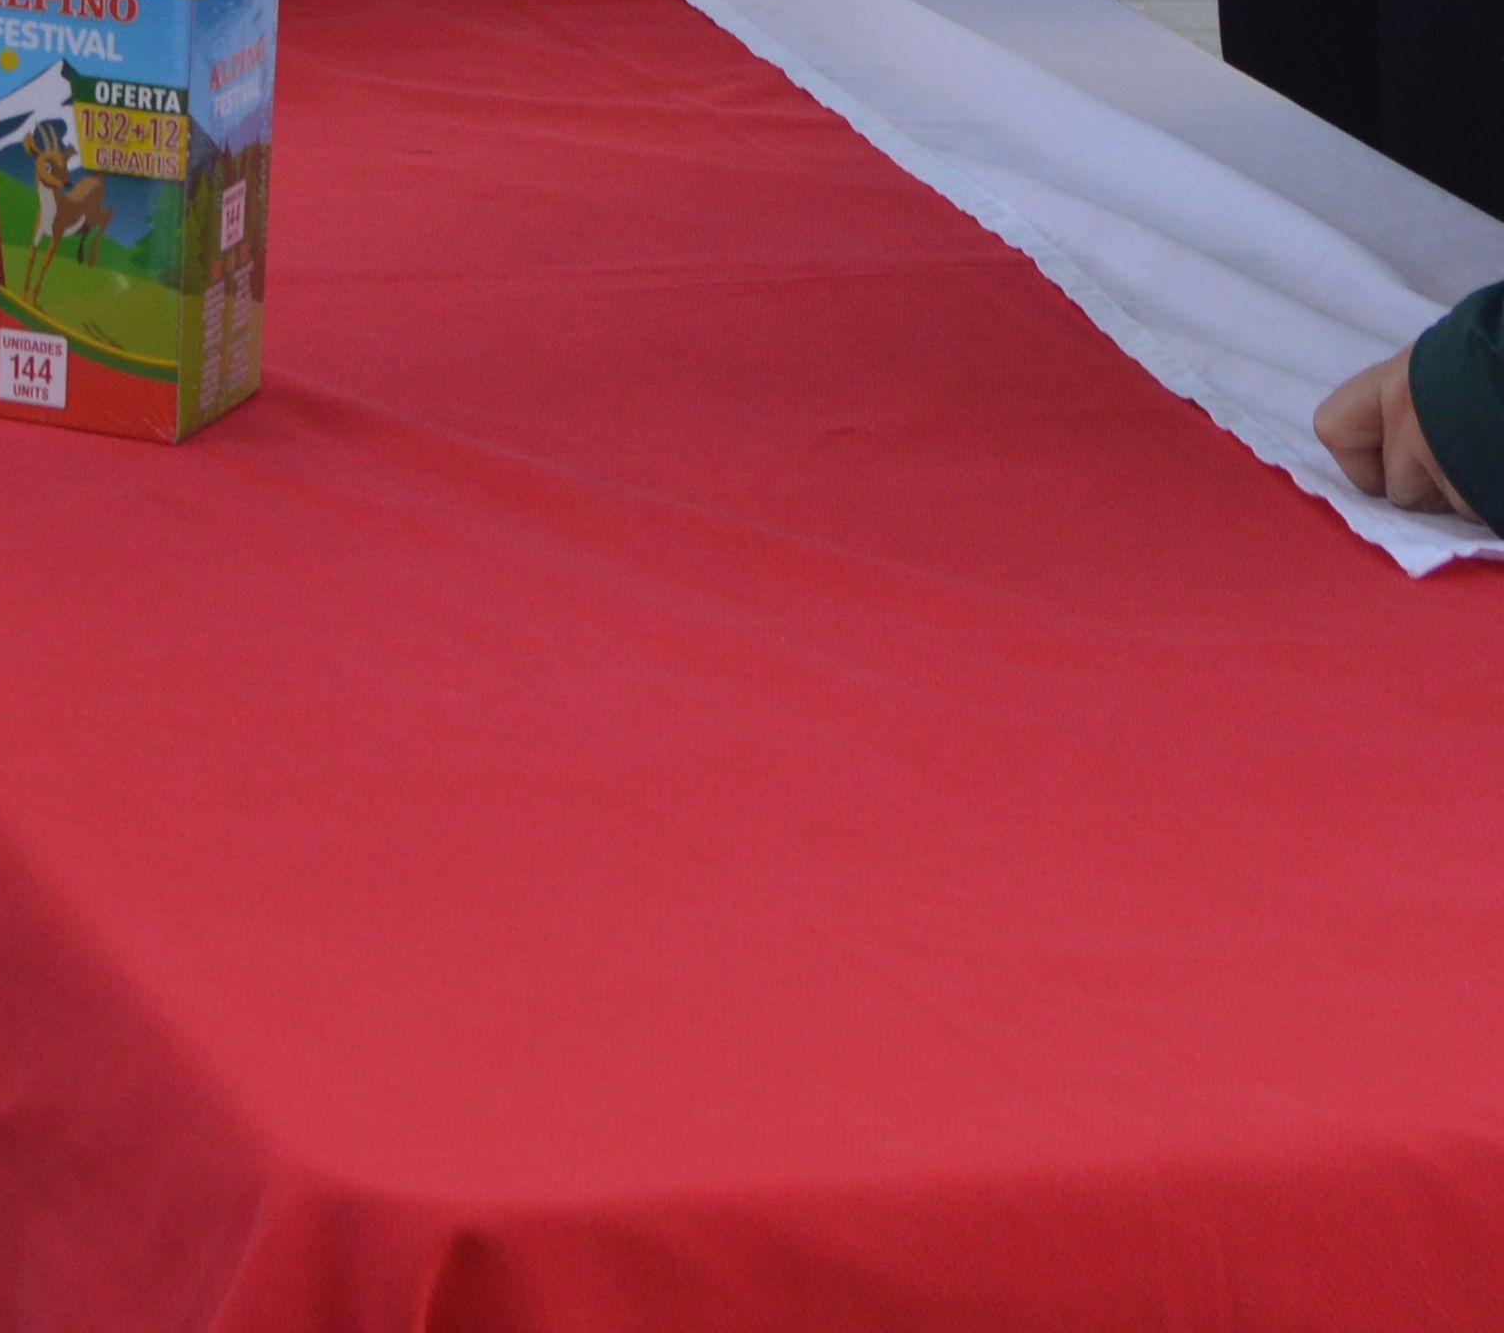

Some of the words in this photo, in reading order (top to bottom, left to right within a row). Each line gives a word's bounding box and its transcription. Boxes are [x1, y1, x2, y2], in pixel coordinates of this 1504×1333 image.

[209, 38, 266, 92] ALPINO
[95, 81, 182, 114] OFERTA
[81, 108, 181, 151] 132+12
[95, 147, 180, 176] GRATIS
[226, 203, 241, 230] 144
[2, 335, 63, 357] UNIDADES
[10, 353, 53, 385] 144
[13, 384, 49, 401] UNITS
